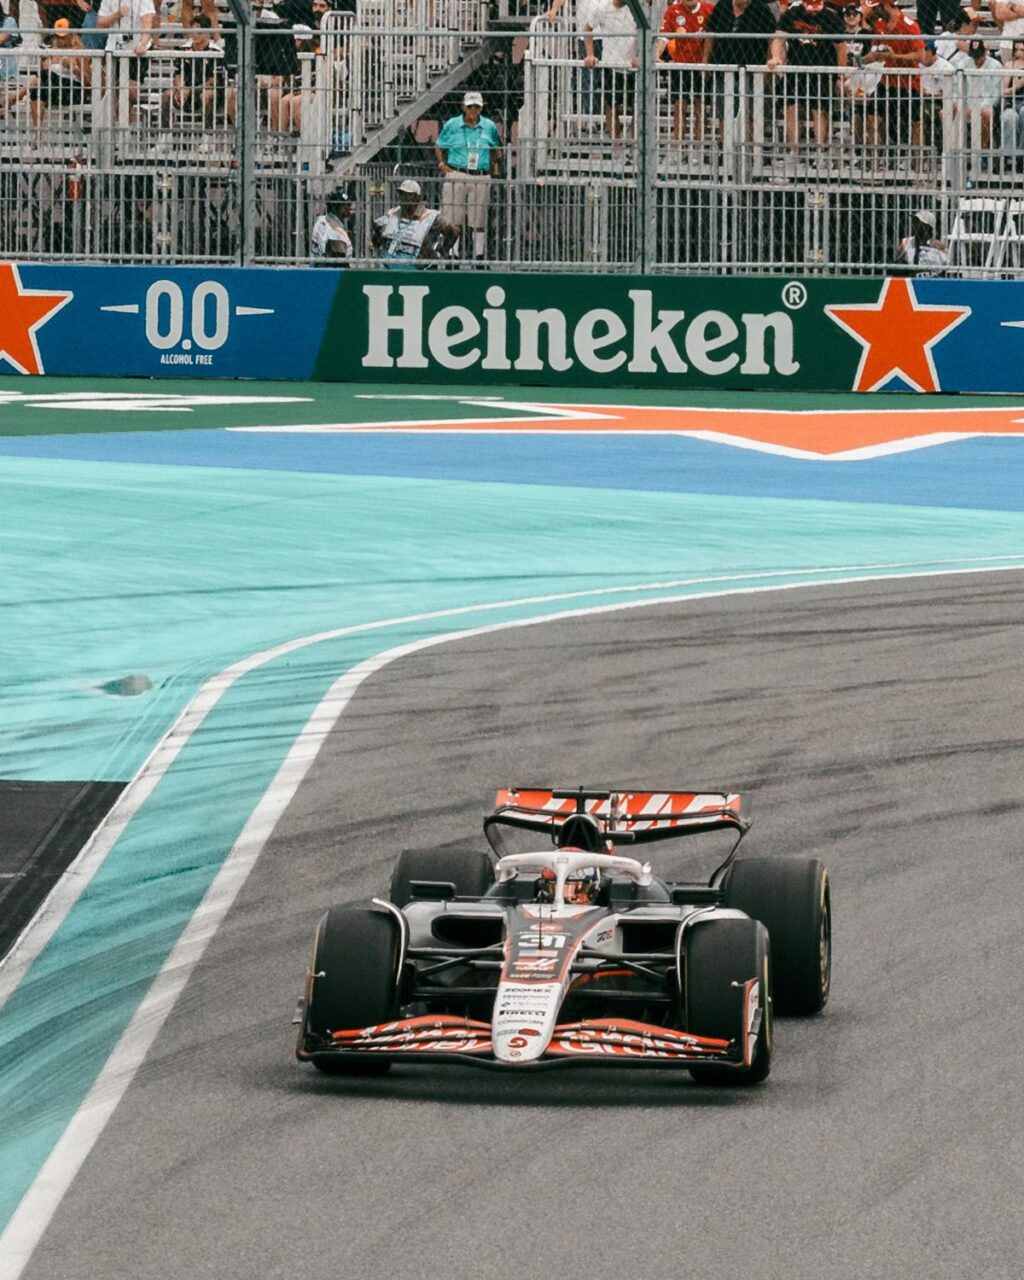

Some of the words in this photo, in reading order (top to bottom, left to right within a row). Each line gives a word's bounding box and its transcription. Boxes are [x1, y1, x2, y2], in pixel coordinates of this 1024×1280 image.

[145, 279, 230, 350] 0.0
[361, 284, 800, 376] Heineken
[160, 354, 193, 365] ALCOHOL
[195, 354, 213, 365] FREE
